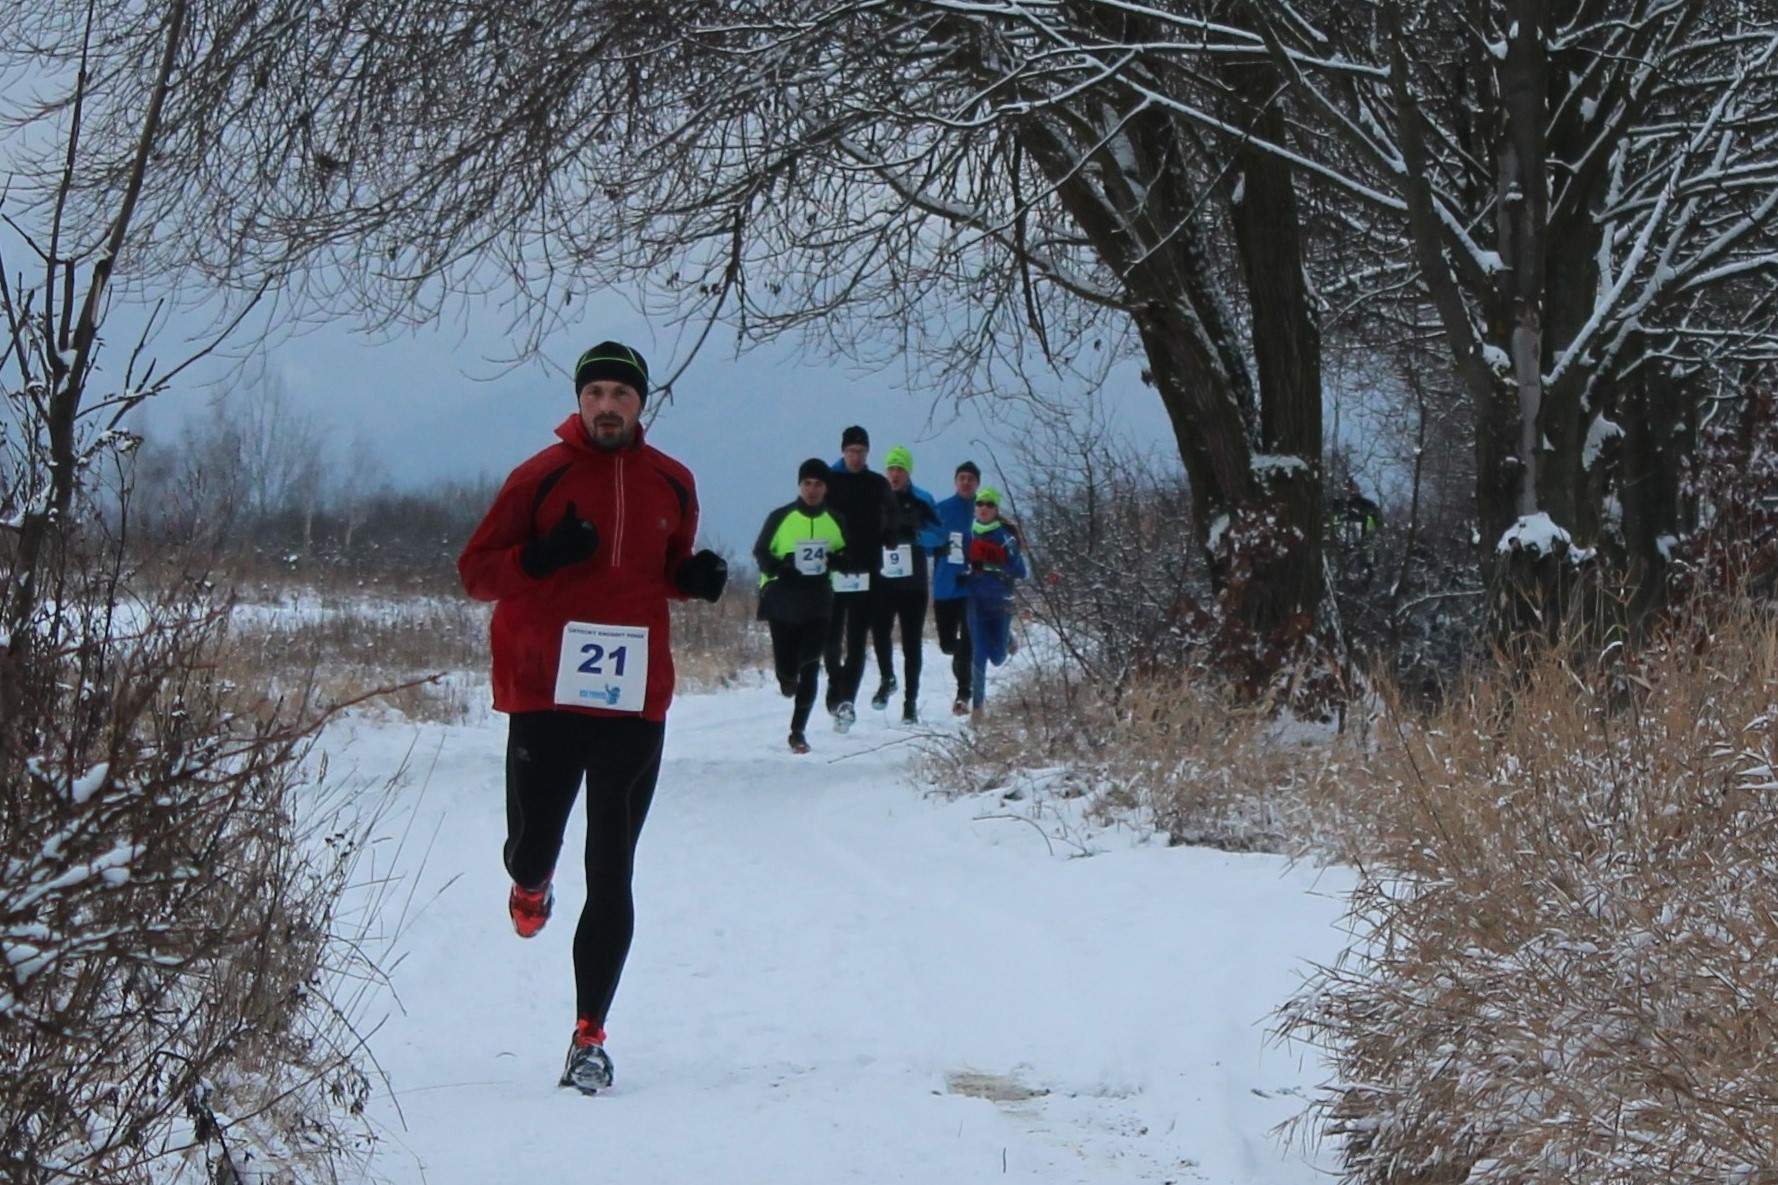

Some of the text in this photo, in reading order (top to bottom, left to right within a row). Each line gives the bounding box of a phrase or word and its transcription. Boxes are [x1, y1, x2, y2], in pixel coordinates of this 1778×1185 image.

[803, 547, 825, 560] 24
[890, 553, 899, 565] 9
[577, 643, 627, 677] 21
